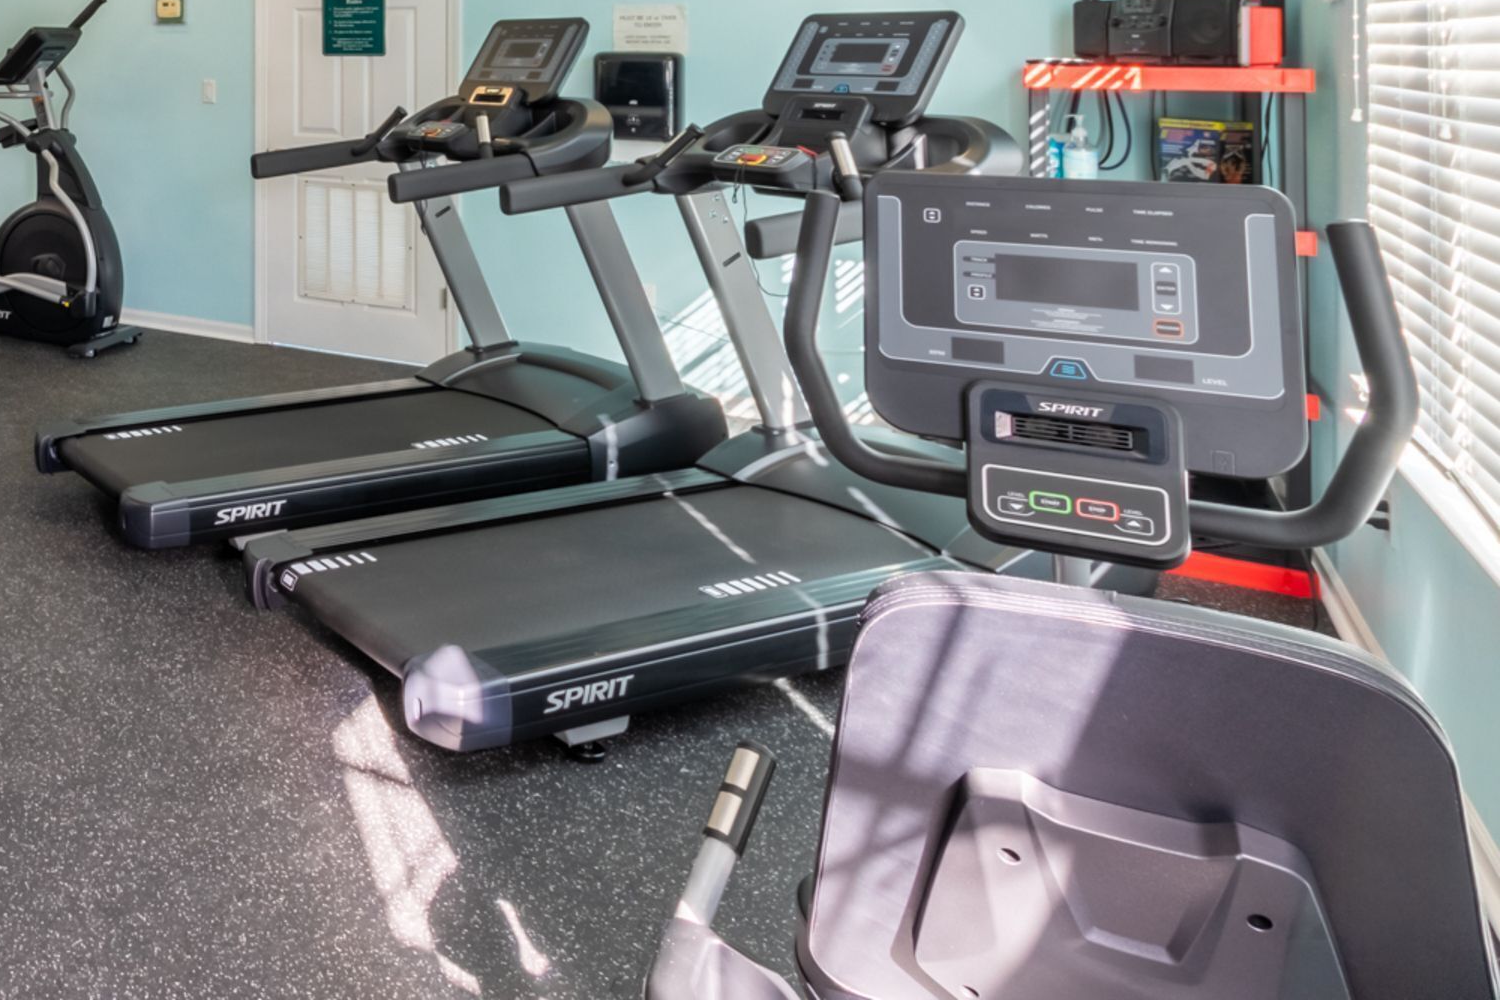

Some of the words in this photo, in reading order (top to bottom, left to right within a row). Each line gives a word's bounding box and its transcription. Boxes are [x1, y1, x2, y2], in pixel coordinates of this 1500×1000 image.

[1202, 377, 1228, 387] LEVEL
[1038, 402, 1104, 418] SPIRIT
[214, 500, 288, 526] SPIRIT
[543, 674, 635, 714] SPIRIT
